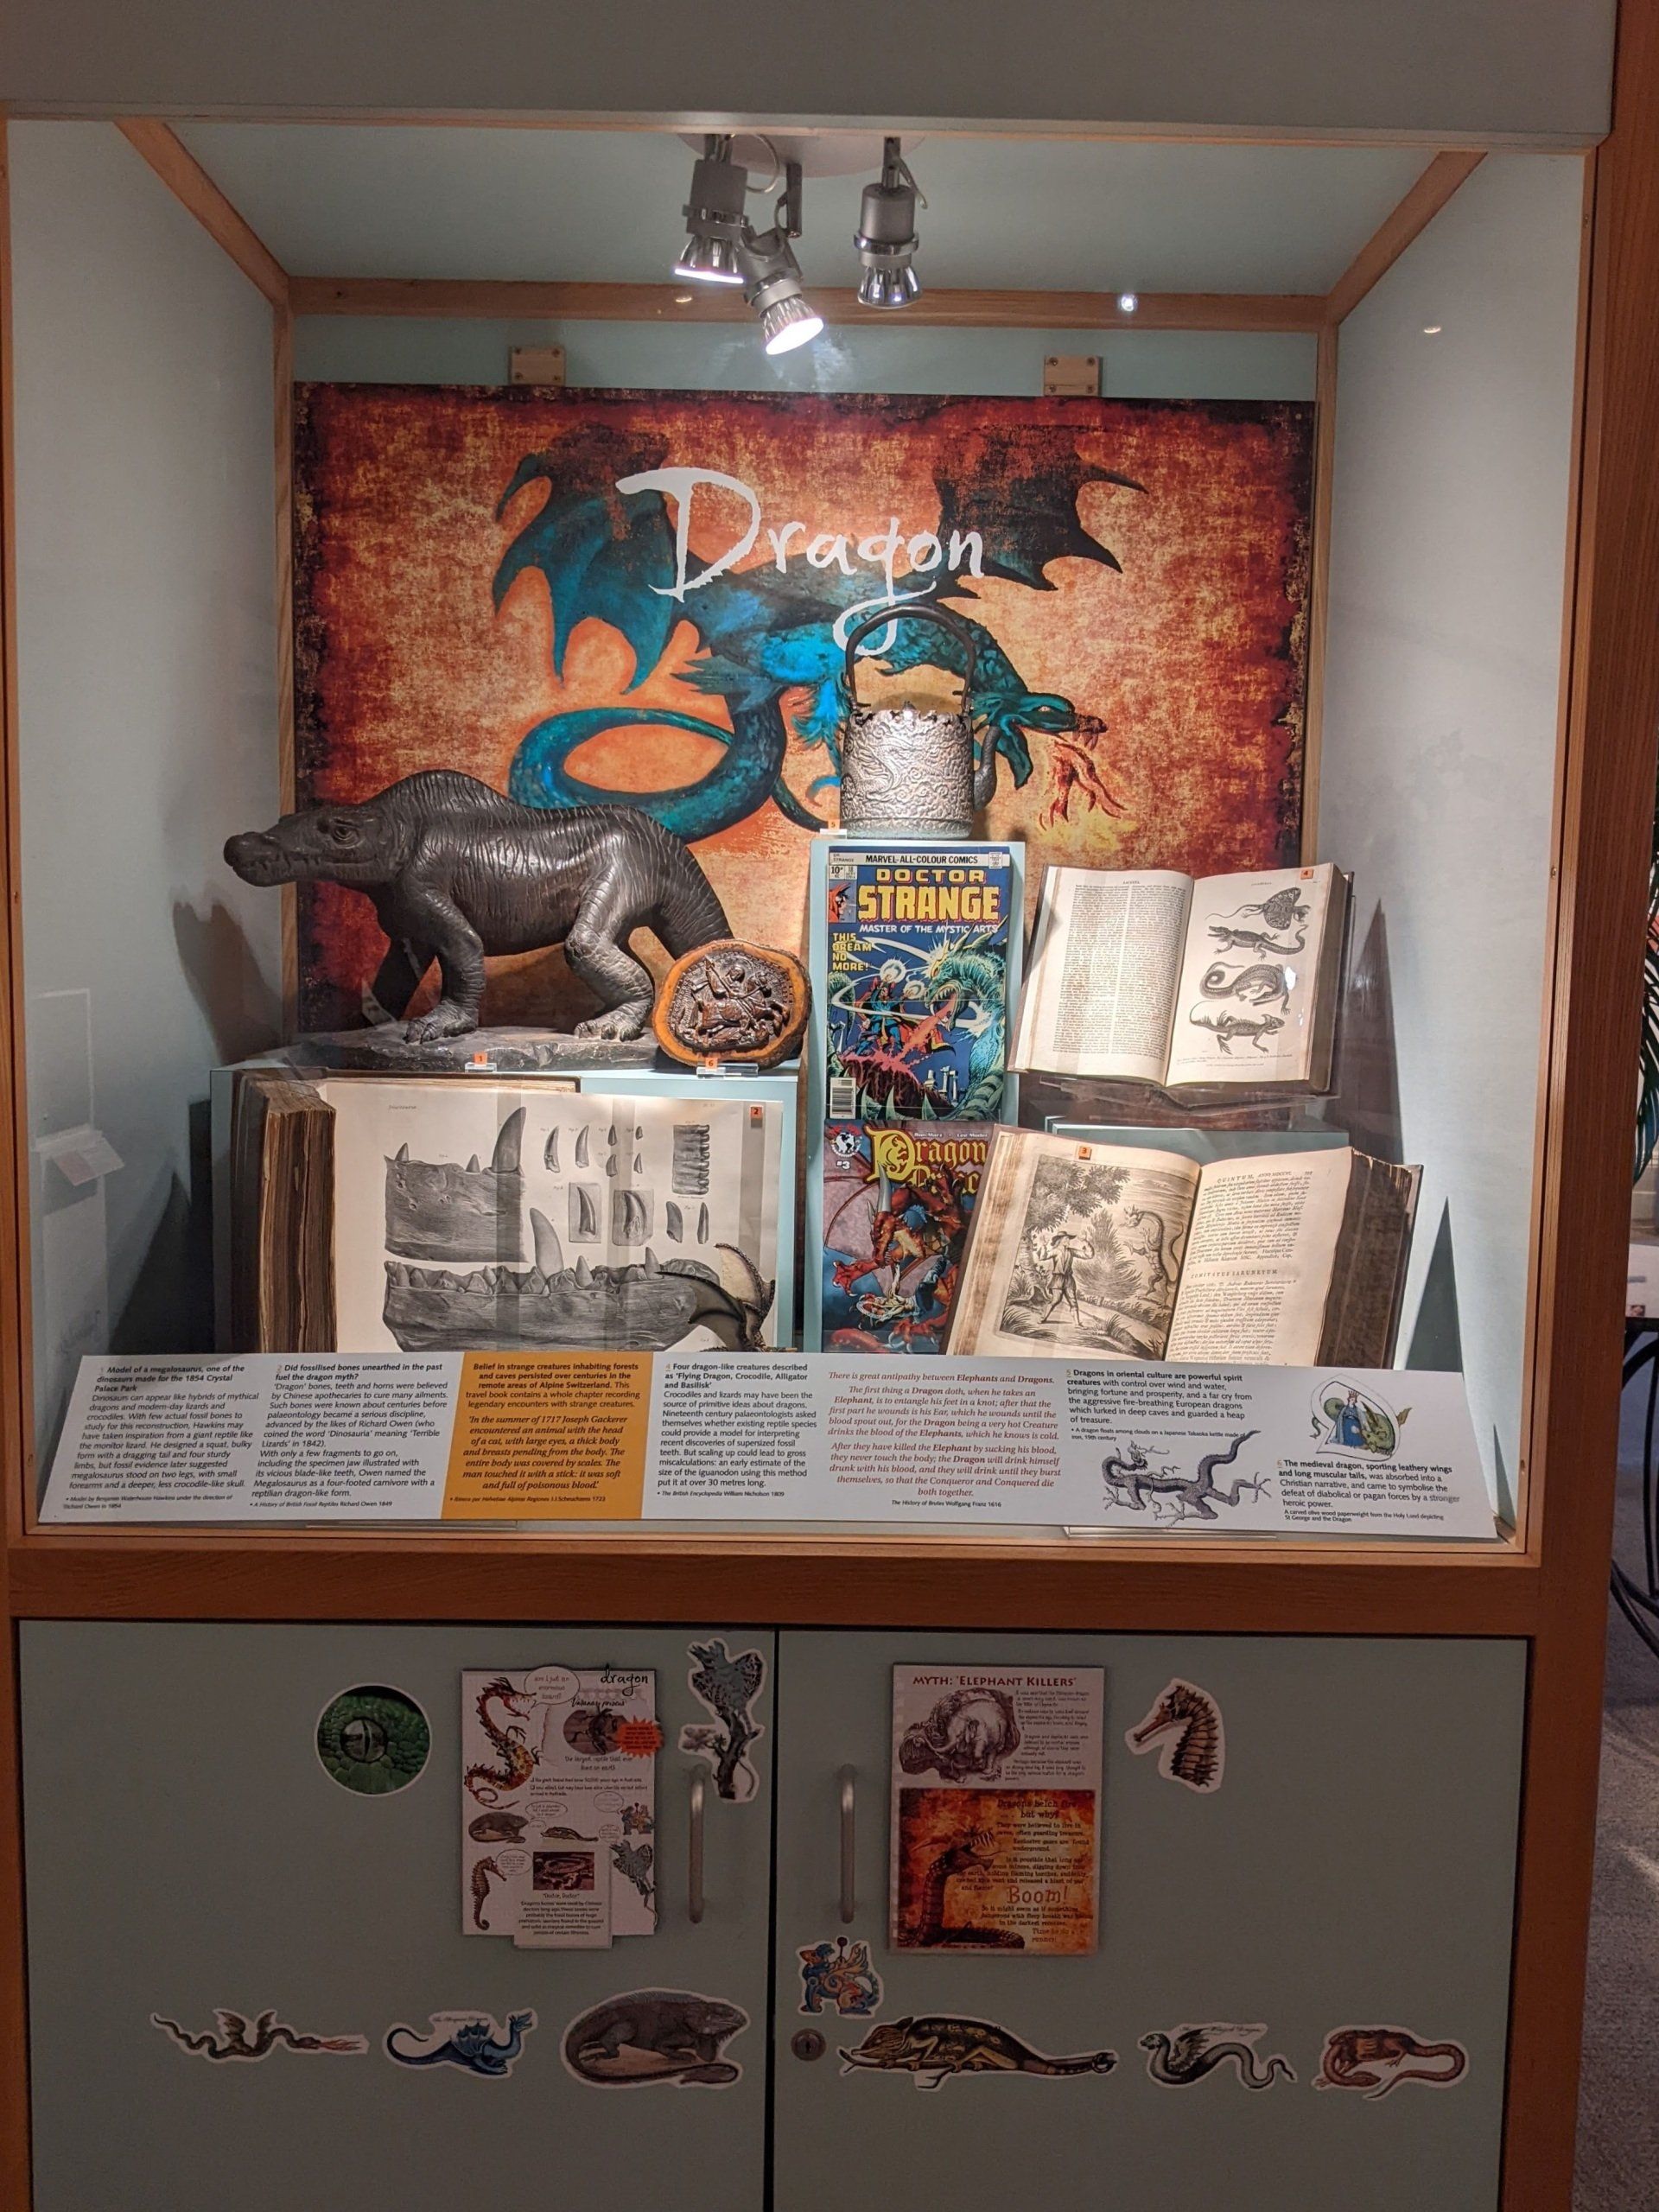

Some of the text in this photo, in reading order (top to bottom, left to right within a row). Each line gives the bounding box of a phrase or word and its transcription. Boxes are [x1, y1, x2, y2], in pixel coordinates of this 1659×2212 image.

[614, 467, 983, 656] Dragon
[948, 855, 978, 864] COMICS
[875, 868, 988, 883] DOCTOR
[858, 885, 1002, 923] STRANGE
[859, 924, 999, 934] MASTER OF THE MYSTIC ARTS
[832, 932, 856, 942] THIS
[832, 942, 873, 951] DREAM
[832, 952, 848, 962] NO
[832, 962, 870, 971] MORE!
[865, 1126, 988, 1182] Dragon
[836, 1161, 850, 1170] #3
[106, 1365, 132, 1374] Model
[232, 1363, 245, 1372] the
[426, 1363, 442, 1372] past
[506, 1362, 535, 1371] strange
[573, 1362, 612, 1371] inhabiting
[672, 1362, 690, 1370] Four
[691, 1362, 734, 1372] dragon-like
[206, 1373, 233, 1383] Crystal
[306, 1372, 334, 1382] dragon
[334, 1372, 359, 1382] myth?
[518, 1371, 553, 1381] persisted
[702, 1371, 733, 1382] Dragon,
[734, 1372, 773, 1381] Crocodile,
[775, 1372, 808, 1382] Alligator
[830, 1370, 1055, 1386] There is great antipathy between Elephants and Dragons.
[1073, 1369, 1105, 1379] Dragons
[1116, 1370, 1145, 1379] oriental
[1147, 1371, 1173, 1380] culture
[1188, 1372, 1222, 1382] powerful
[1223, 1373, 1243, 1383] spirit
[94, 1383, 137, 1392] Palace Park
[308, 1381, 334, 1390] bones,
[334, 1381, 355, 1389] teeth
[356, 1381, 372, 1389] and
[372, 1381, 395, 1389] horns
[416, 1381, 448, 1389] believed
[539, 1381, 564, 1390] Alpine
[1066, 1378, 1101, 1387] creatures
[1121, 1379, 1147, 1388] control
[1187, 1381, 1202, 1389] and
[562, 1415, 589, 1425] Joseph
[1070, 1414, 1112, 1425] of treasure.
[1284, 1459, 1299, 1467] The
[1300, 1459, 1334, 1469] medieval
[1335, 1461, 1364, 1471] dragon,
[1365, 1462, 1397, 1472] sporting
[1398, 1463, 1428, 1474] leathery
[1429, 1465, 1452, 1475] wings
[1278, 1468, 1293, 1477] and
[1294, 1469, 1313, 1479] long
[1313, 1470, 1347, 1478] muscular
[1349, 1471, 1367, 1480] tails,
[1385, 1471, 1419, 1481] absorbed
[1307, 1500, 1333, 1510] power.
[601, 1664, 649, 1696] dragon
[912, 1676, 953, 1686] MYTH:
[1020, 1809, 1035, 1818] but
[1006, 1886, 1068, 1904] Boom!
